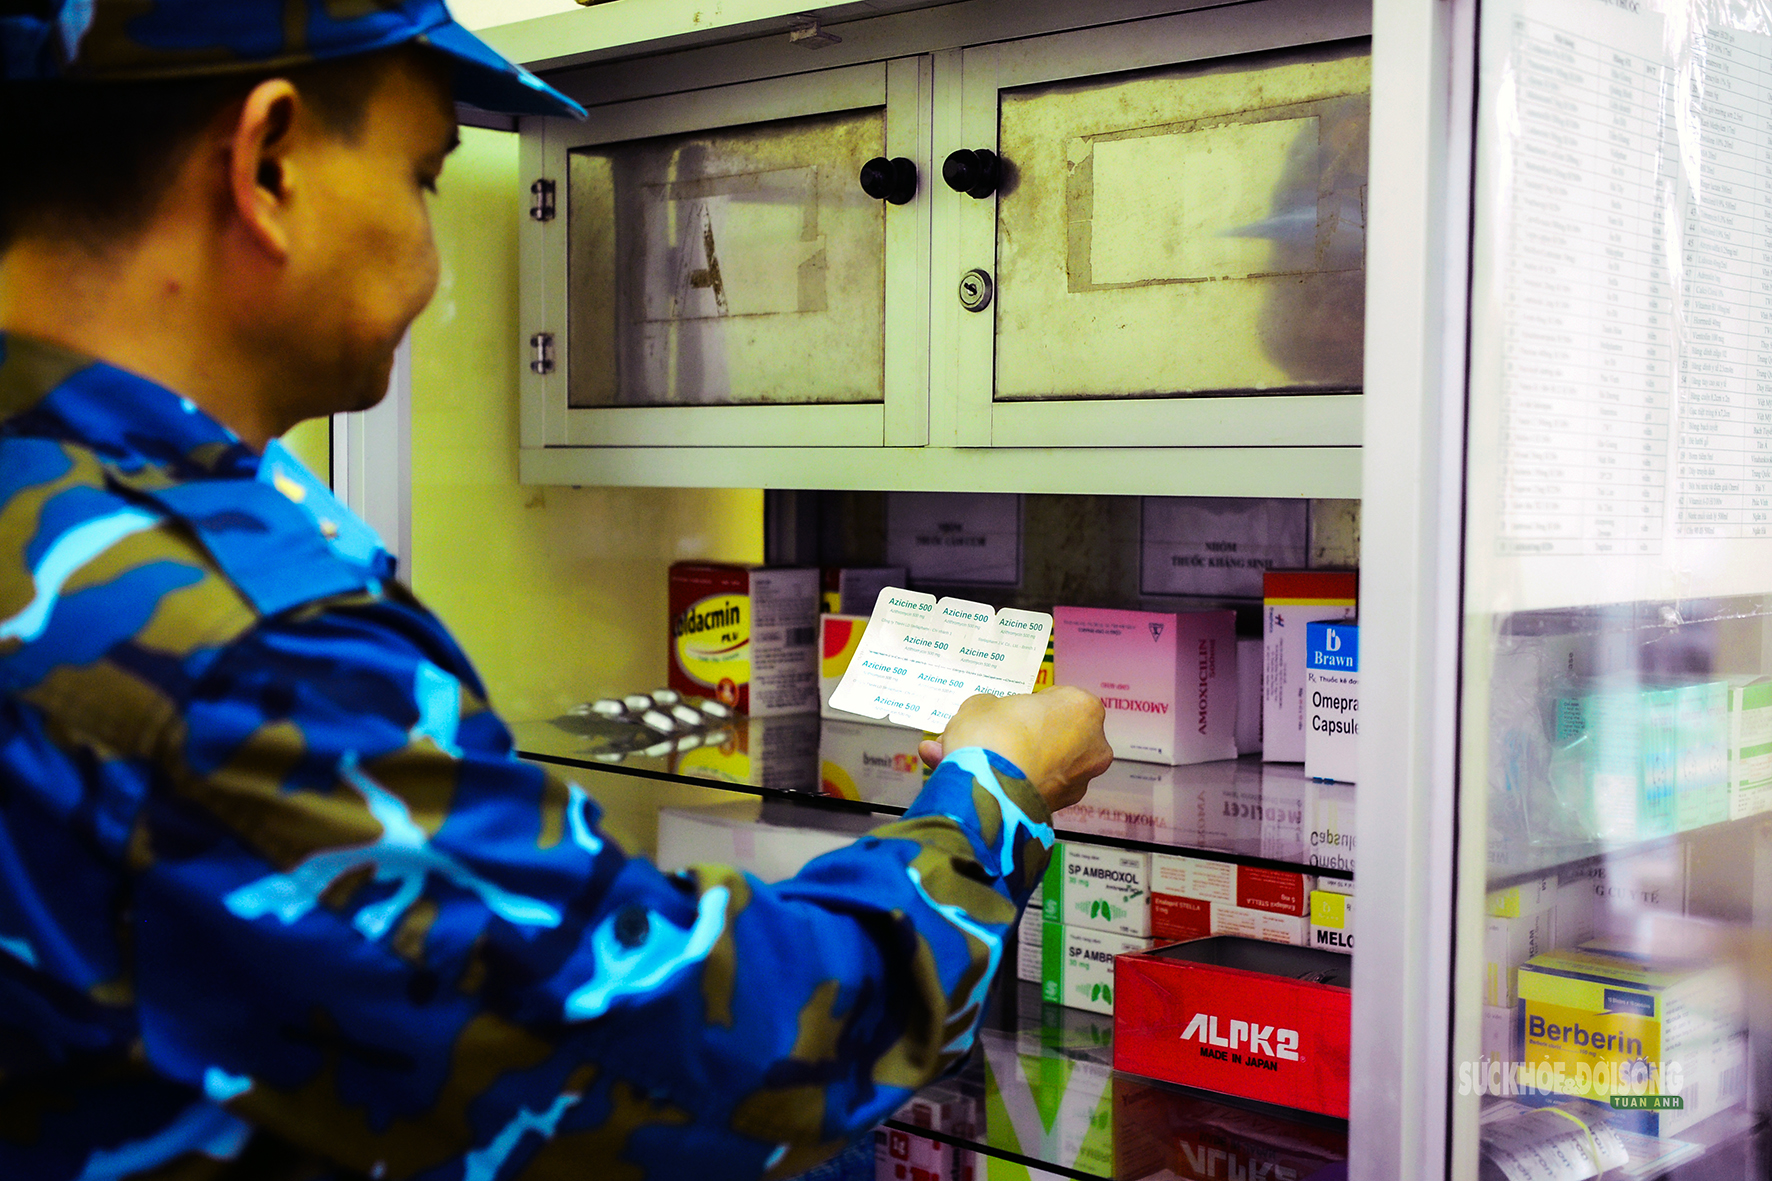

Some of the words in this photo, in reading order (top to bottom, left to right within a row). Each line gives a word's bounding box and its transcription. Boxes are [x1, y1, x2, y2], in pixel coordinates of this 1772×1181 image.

[888, 598, 918, 609] Azicine
[919, 603, 933, 612] 500
[943, 608, 972, 620] Azicine
[974, 614, 989, 623] 500
[999, 618, 1028, 630] Azicine
[1029, 623, 1043, 632] 500
[903, 635, 932, 648] Azicine
[934, 641, 949, 650] 500
[959, 646, 989, 659] Azicine
[990, 652, 1005, 662] 500
[1315, 651, 1353, 667] Brawn
[862, 660, 892, 673] Azicine
[892, 667, 908, 676] 500
[918, 673, 948, 686] Azicine
[949, 679, 964, 689] 500
[1198, 639, 1207, 735] AMOXICILIN
[1320, 676, 1338, 684] Thuốc
[974, 685, 1004, 698] Azicine
[874, 696, 904, 709] Azicine
[905, 703, 921, 712] 500
[1100, 697, 1169, 714] AMOXICILIN
[1312, 691, 1358, 714] Omepra
[931, 709, 954, 720] Azici
[1068, 864, 1081, 875] SP
[1083, 867, 1139, 885] AMBROXOL
[1179, 902, 1201, 911] STELLA
[1246, 898, 1269, 908] STELLA
[1069, 946, 1082, 957] SP
[1084, 950, 1114, 964] AMBR
[1180, 1013, 1299, 1062] ALPK2
[1529, 1014, 1642, 1056] Berberin
[1200, 1047, 1228, 1062] MADE
[1232, 1054, 1242, 1064] IN
[1245, 1056, 1278, 1072] JAPAN
